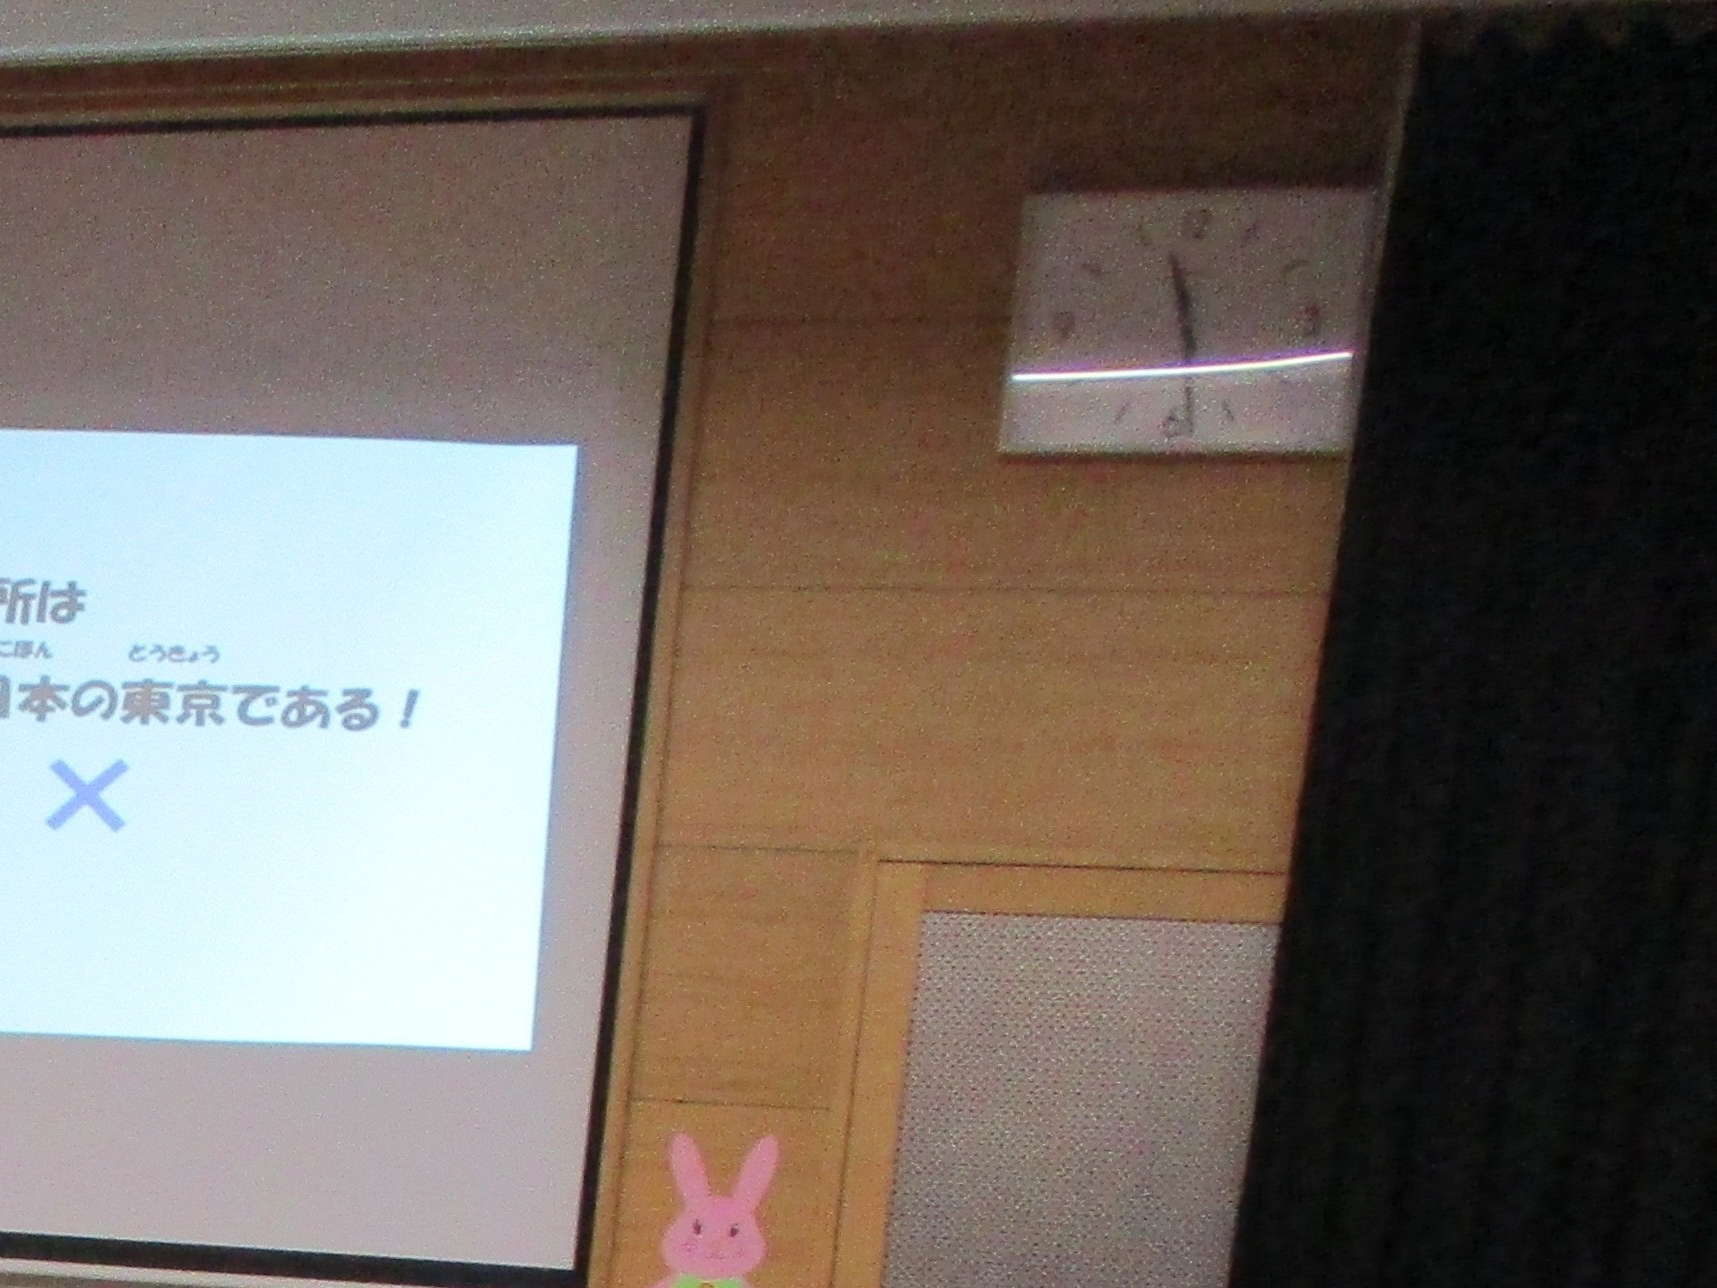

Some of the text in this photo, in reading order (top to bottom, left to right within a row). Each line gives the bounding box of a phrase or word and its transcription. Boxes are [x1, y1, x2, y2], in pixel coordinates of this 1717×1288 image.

[127, 643, 222, 664] とうきょう
